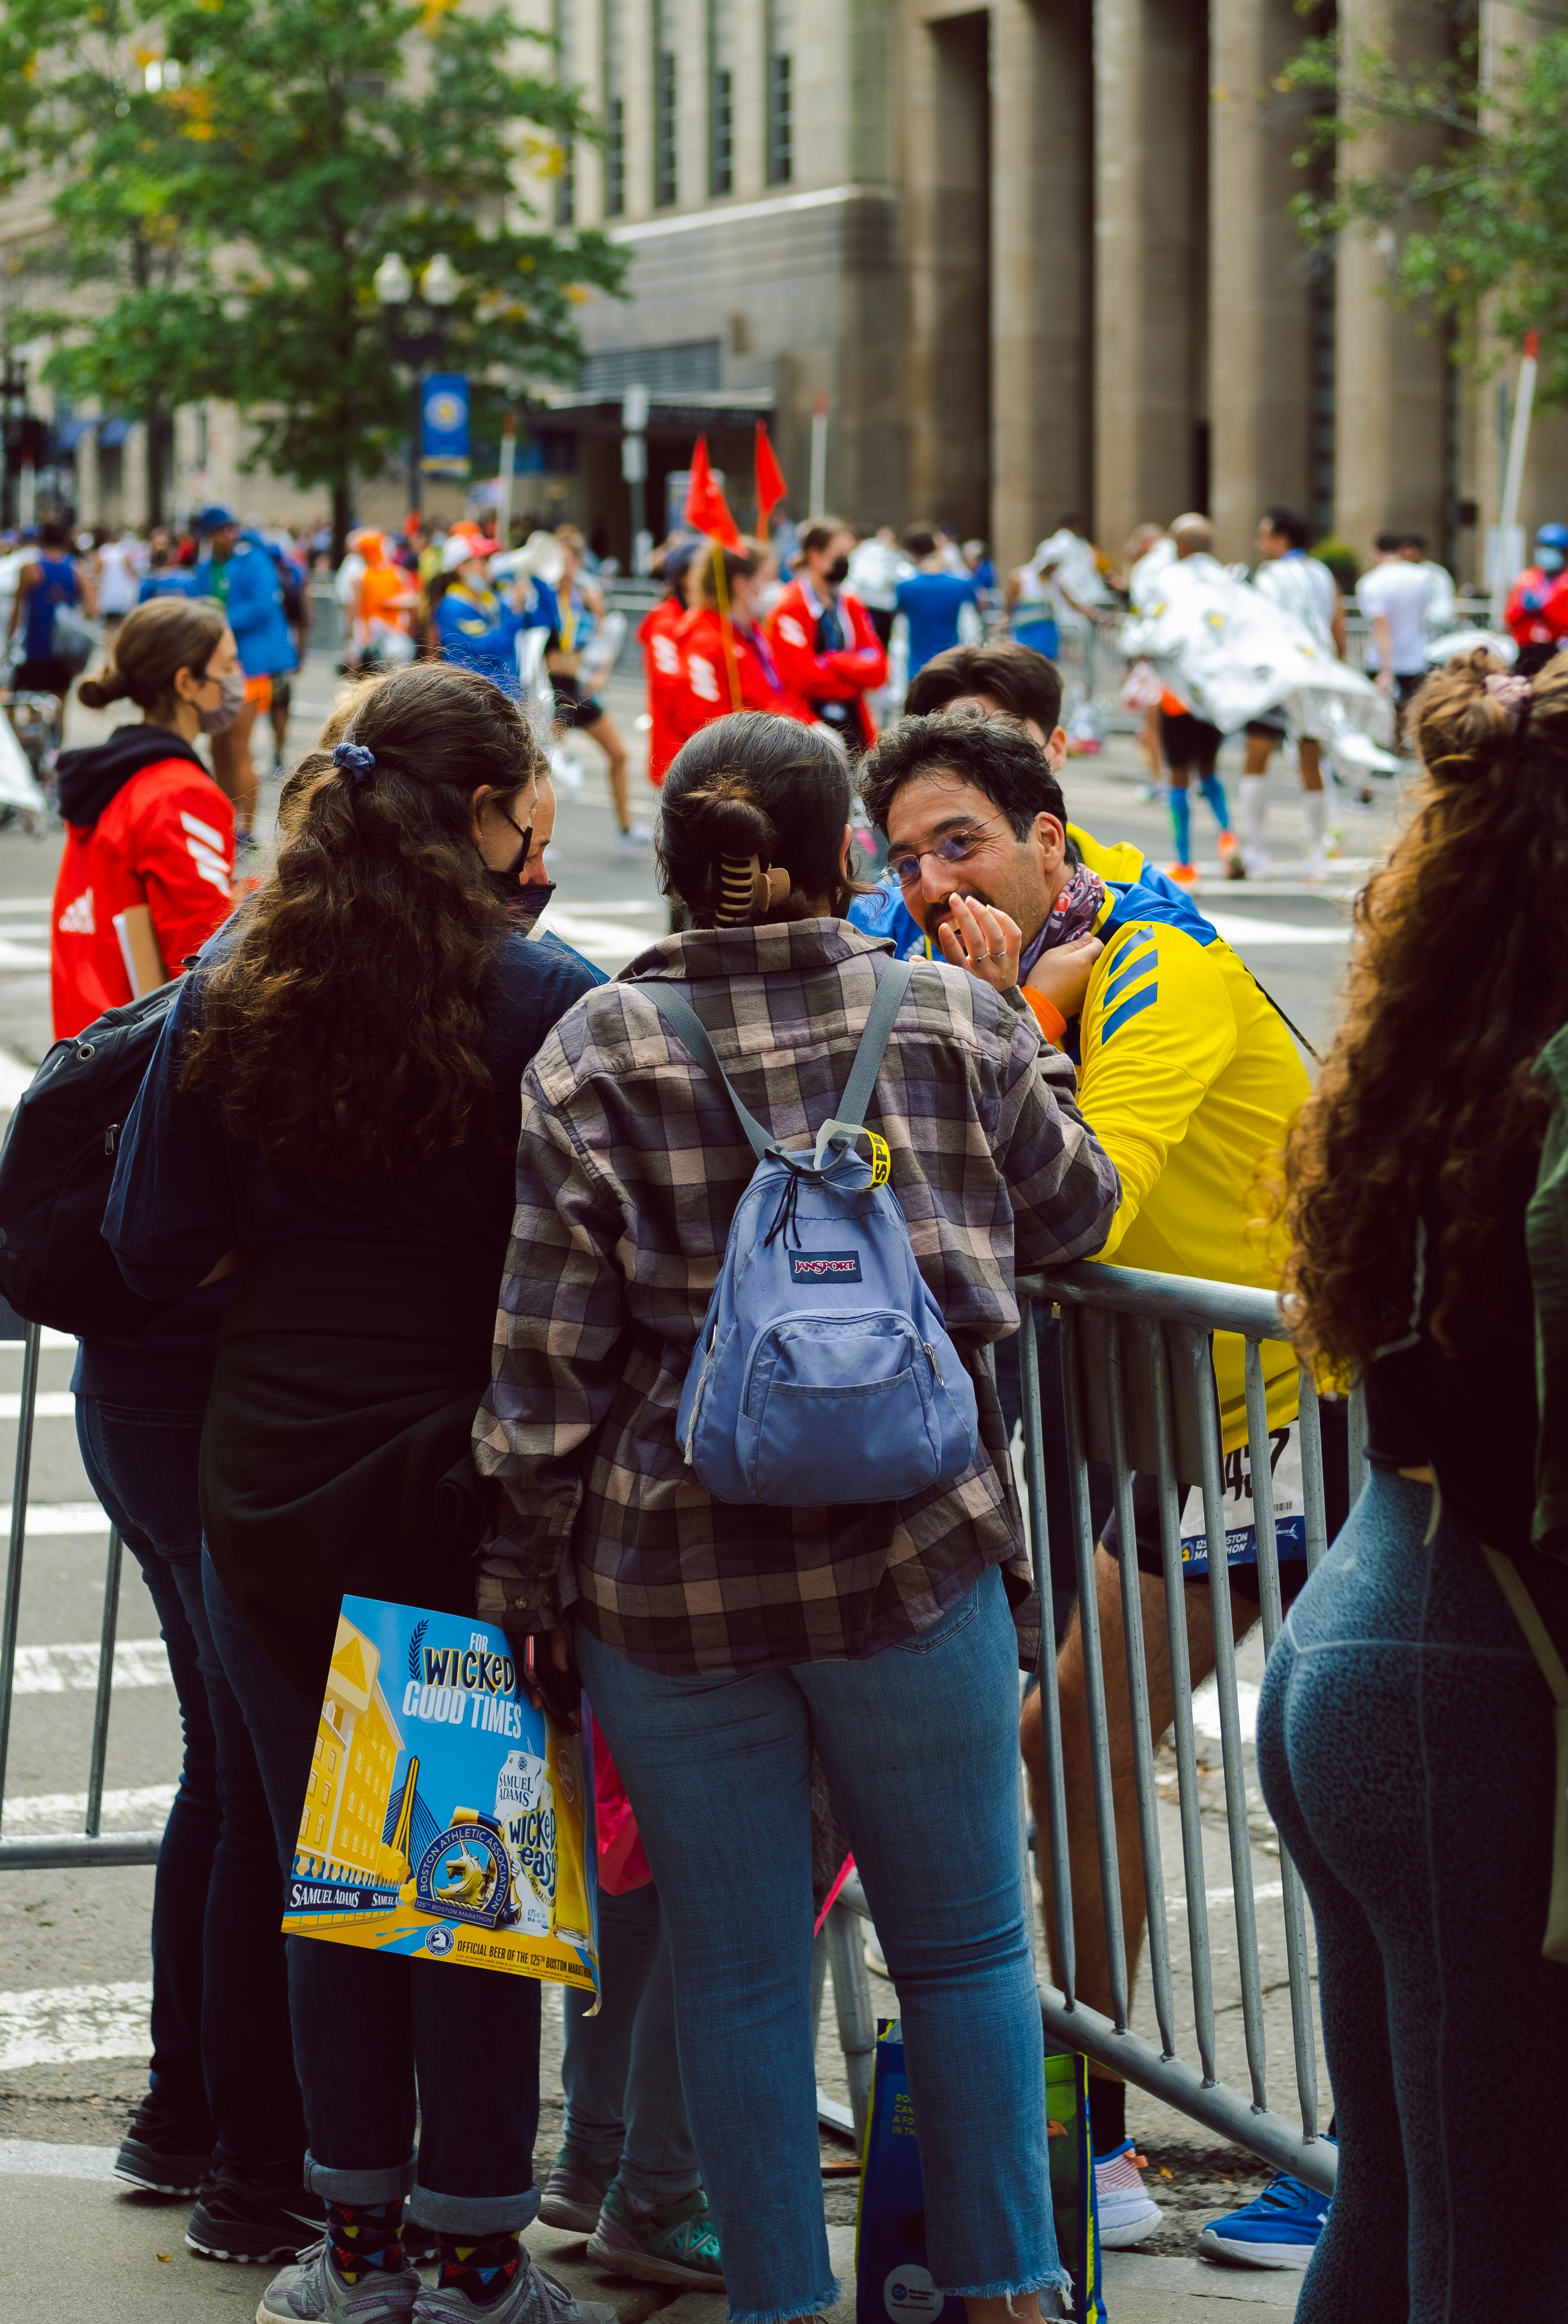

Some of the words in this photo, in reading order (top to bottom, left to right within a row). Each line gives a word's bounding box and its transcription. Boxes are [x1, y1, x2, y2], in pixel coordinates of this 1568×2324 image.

[794, 1260, 855, 1274] JANSPORT
[1226, 1532, 1248, 1545] STON
[469, 1632, 488, 1652] FOR
[403, 1681, 466, 1724] GOOD
[471, 1693, 521, 1739] TIMES
[499, 1772, 533, 1794] SAMUEL
[498, 1788, 529, 1807] ADAMS
[421, 1847, 439, 1892] BOSTON
[441, 1829, 486, 1848] ATHLETIC
[487, 1838, 506, 1909] ASSOCIATION
[290, 1884, 333, 1907] SAMUEL
[333, 1889, 360, 1908] ADAMS
[371, 1893, 394, 1906] SAMUEL
[431, 1905, 457, 1915] BOSTON
[458, 1911, 492, 1923] MARATHON
[458, 1940, 487, 1956] OFFICIAL
[489, 1946, 506, 1959] BEER
[507, 1949, 516, 1961] OF
[517, 1951, 529, 1964] THE
[546, 1957, 567, 1972] BOSTON
[568, 1962, 593, 1979] MARATHON
[896, 2094, 911, 2103] RO
[905, 2127, 917, 2137] TH
